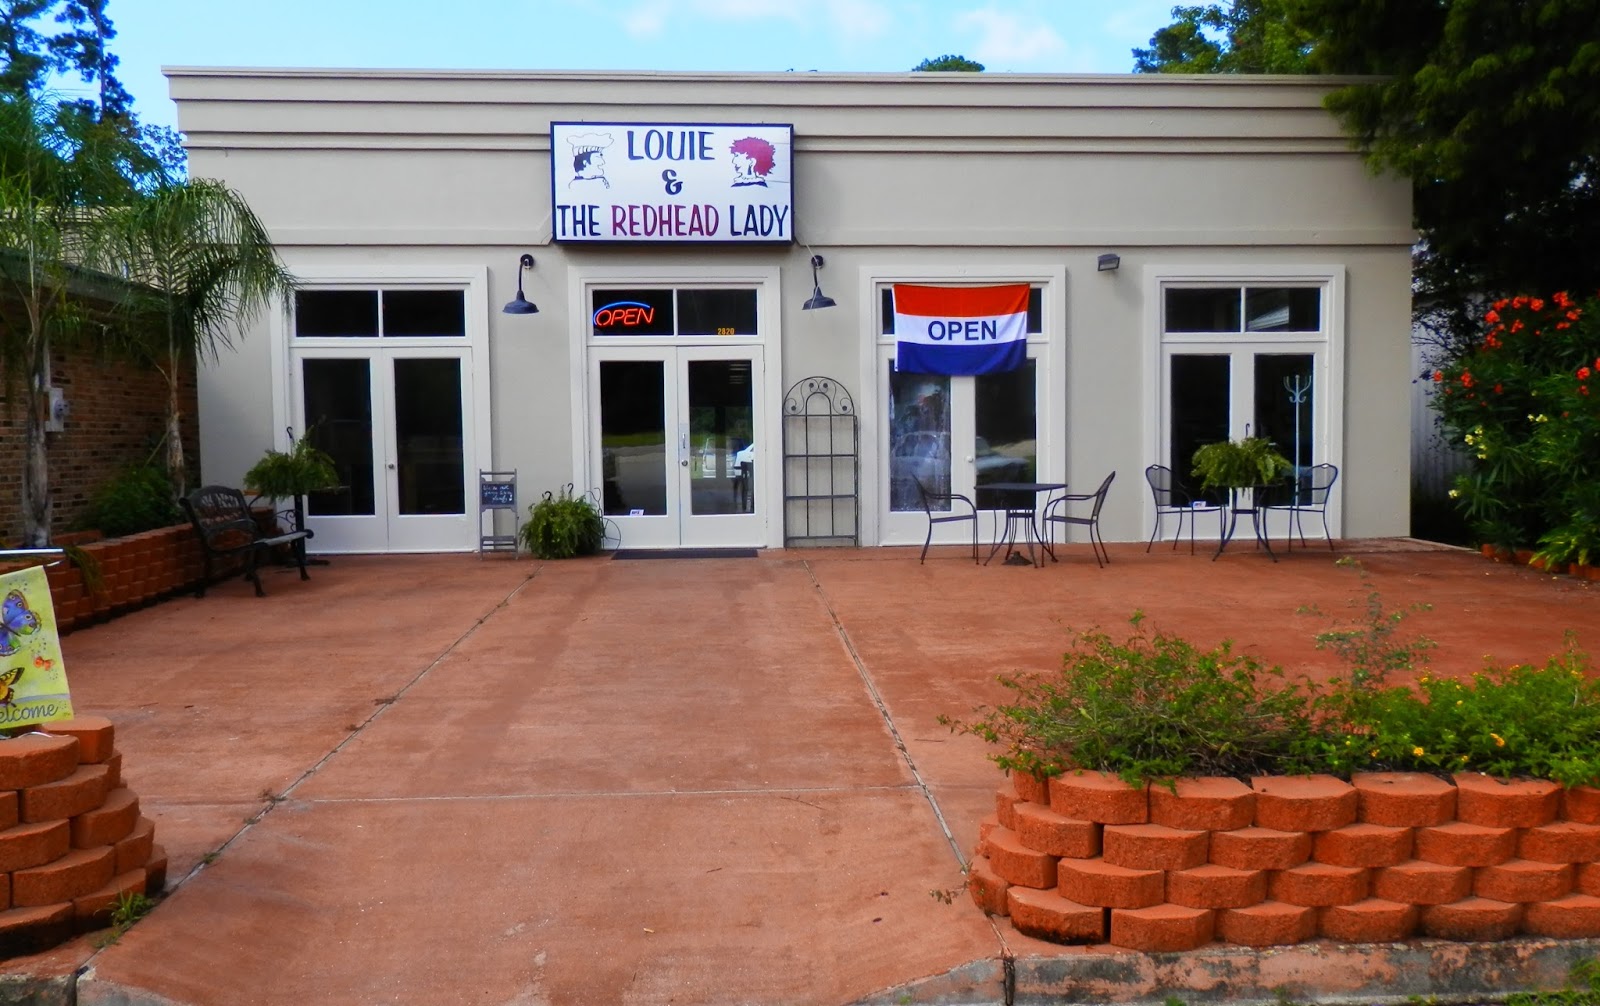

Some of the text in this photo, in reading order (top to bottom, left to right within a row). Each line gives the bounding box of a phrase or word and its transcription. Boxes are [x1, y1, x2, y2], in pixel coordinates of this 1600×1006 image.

[627, 129, 715, 161] LOUIE
[661, 169, 683, 196] &
[556, 204, 789, 237] THE REDHEAD LADY
[595, 307, 655, 326] OPEN
[717, 327, 735, 336] 2820
[927, 320, 997, 341] OPEN
[0, 703, 59, 723] elcome
